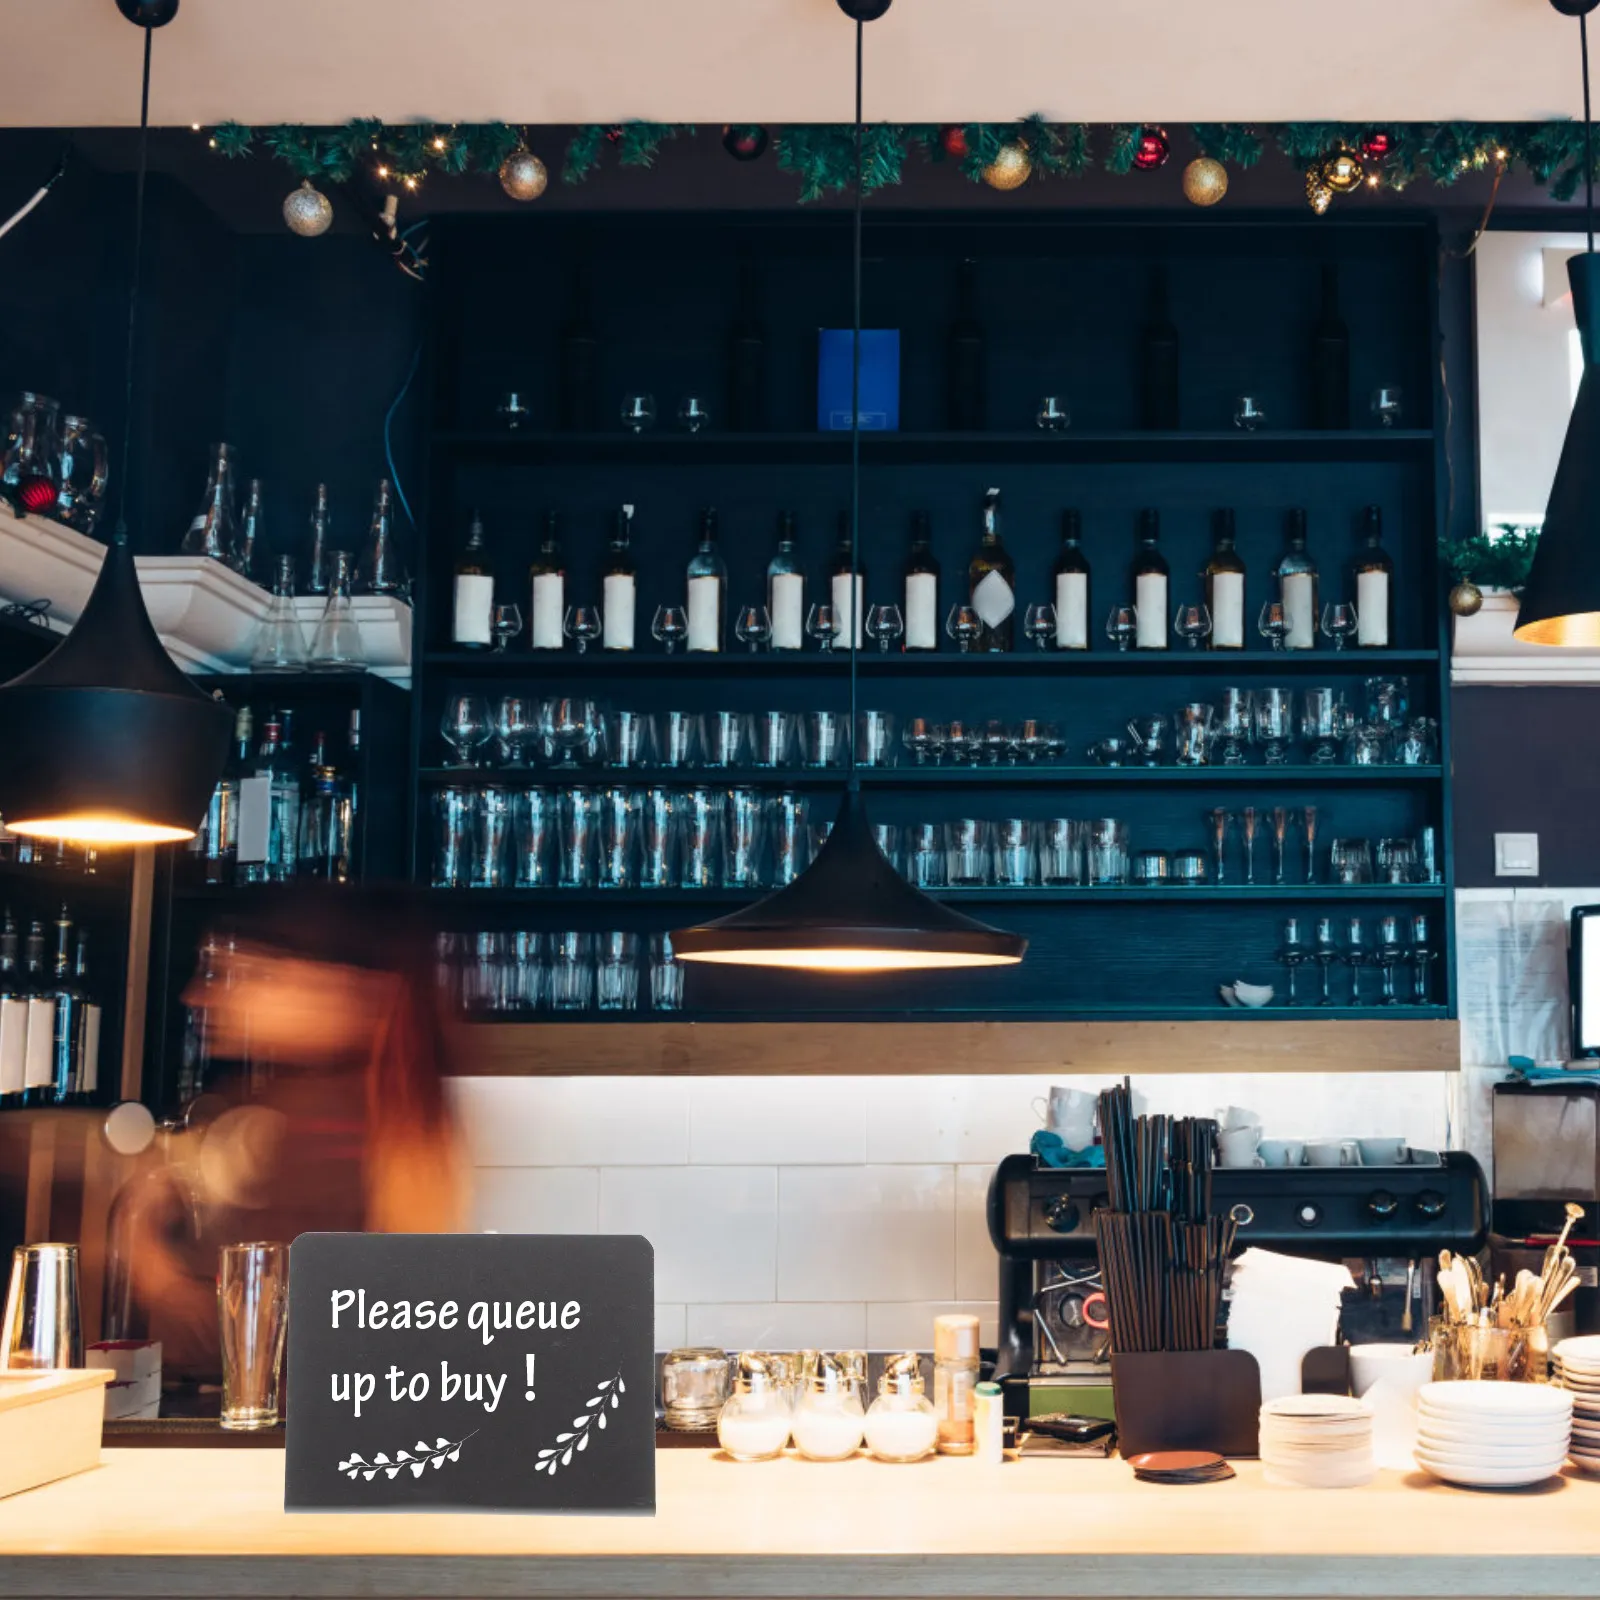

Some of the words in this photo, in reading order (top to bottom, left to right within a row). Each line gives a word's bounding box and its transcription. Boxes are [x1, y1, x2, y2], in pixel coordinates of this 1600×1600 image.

[330, 1288, 459, 1330] Please
[467, 1300, 581, 1346] queue
[331, 1372, 376, 1418] up
[384, 1365, 430, 1402] to
[440, 1360, 508, 1413] buy
